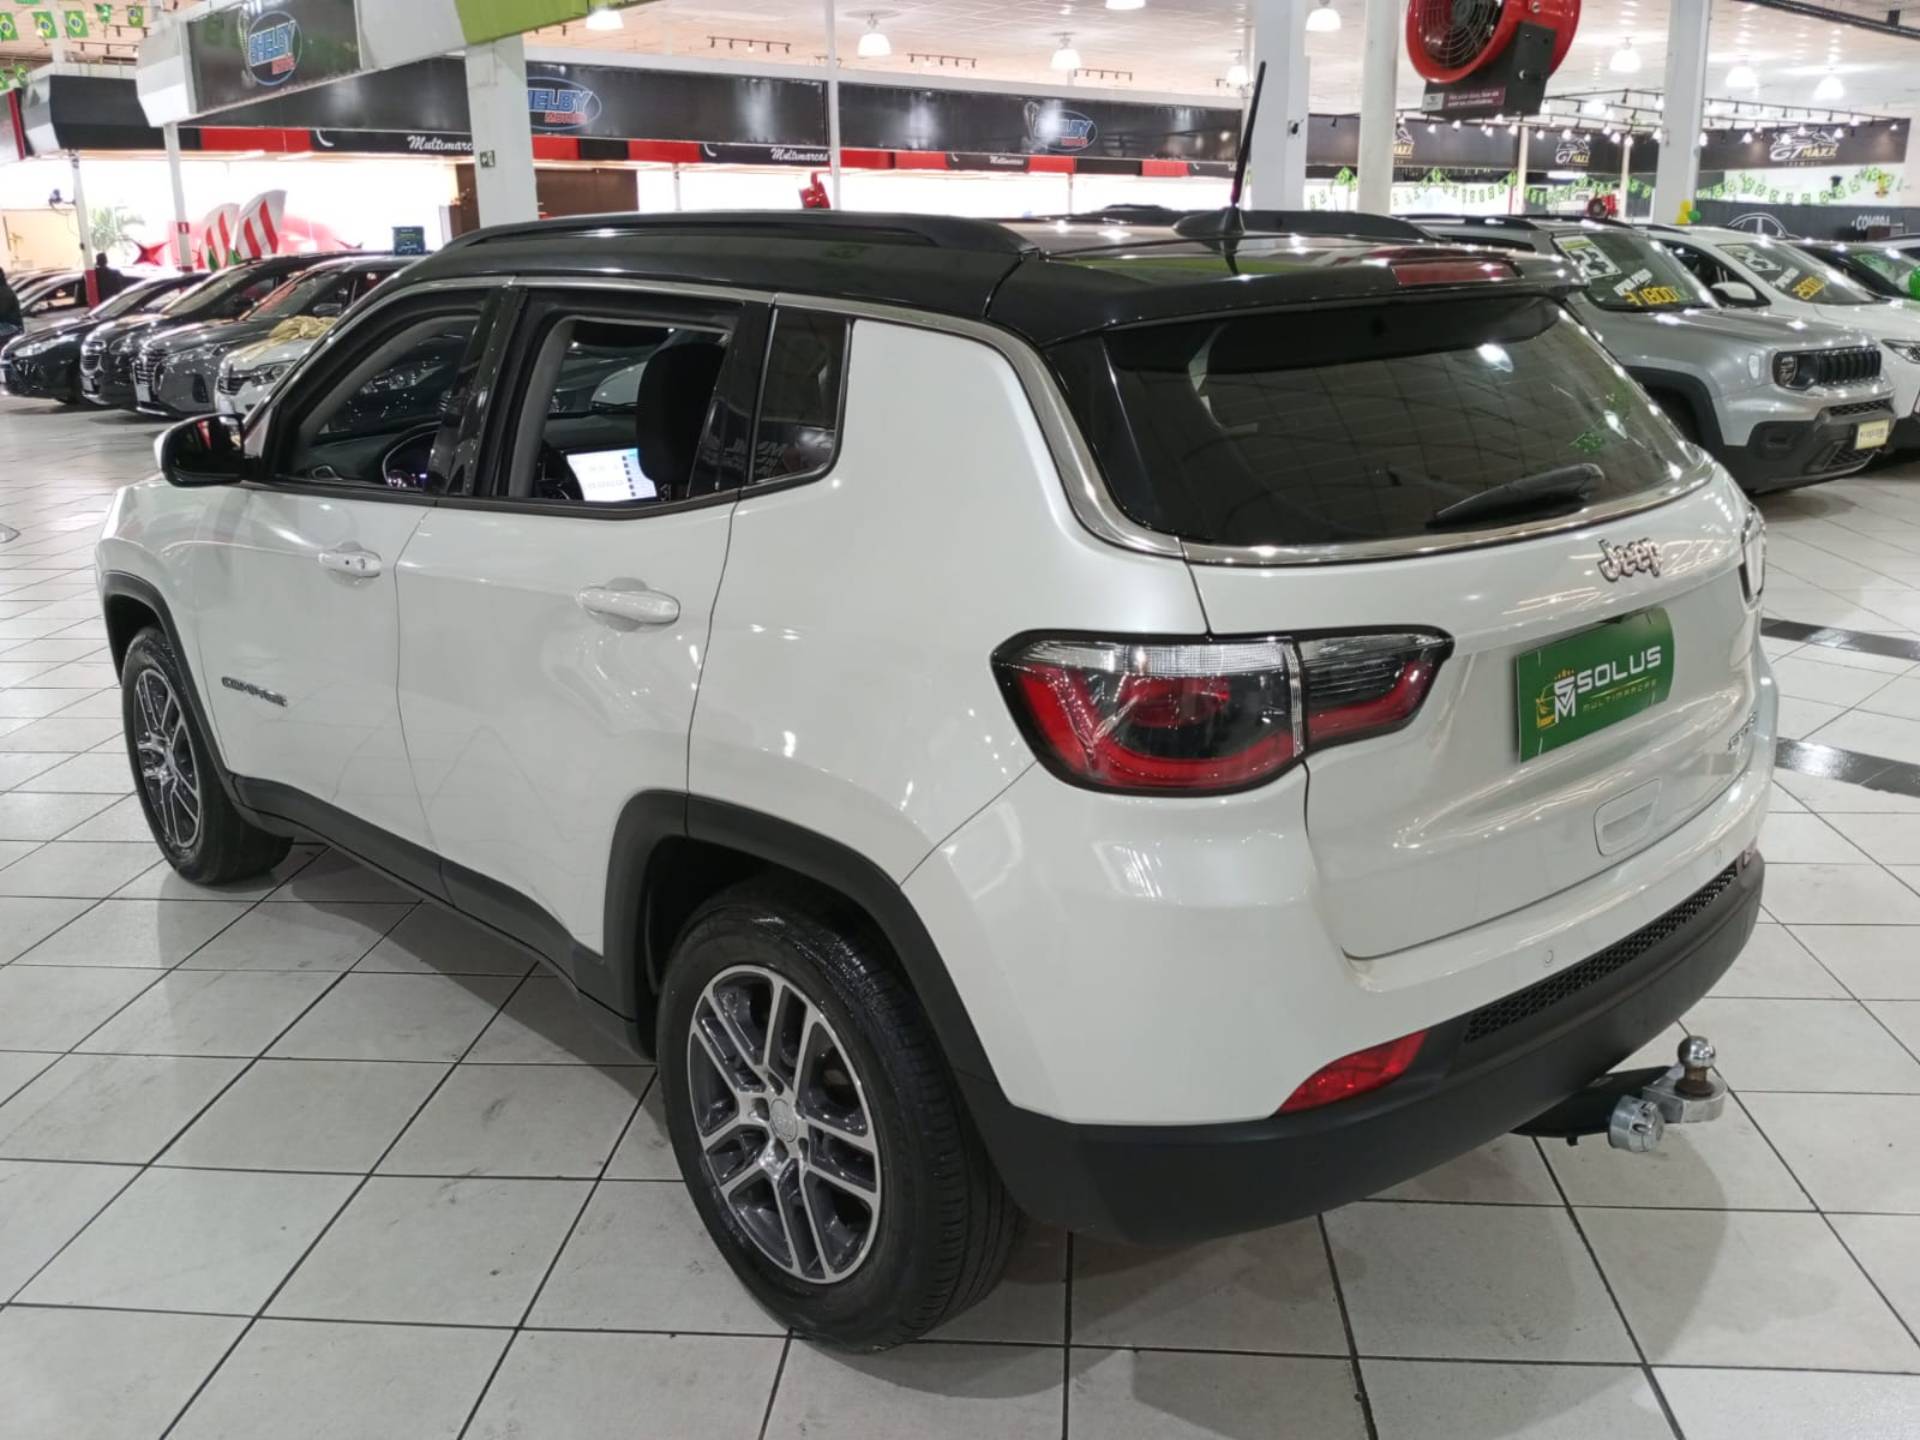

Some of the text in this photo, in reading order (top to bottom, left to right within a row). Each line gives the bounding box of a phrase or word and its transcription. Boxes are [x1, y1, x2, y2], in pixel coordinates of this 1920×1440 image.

[528, 87, 593, 113] ELBY
[407, 134, 474, 152] Multimarc
[1598, 538, 1663, 582] Jeep
[1577, 645, 1662, 694] SOLUS
